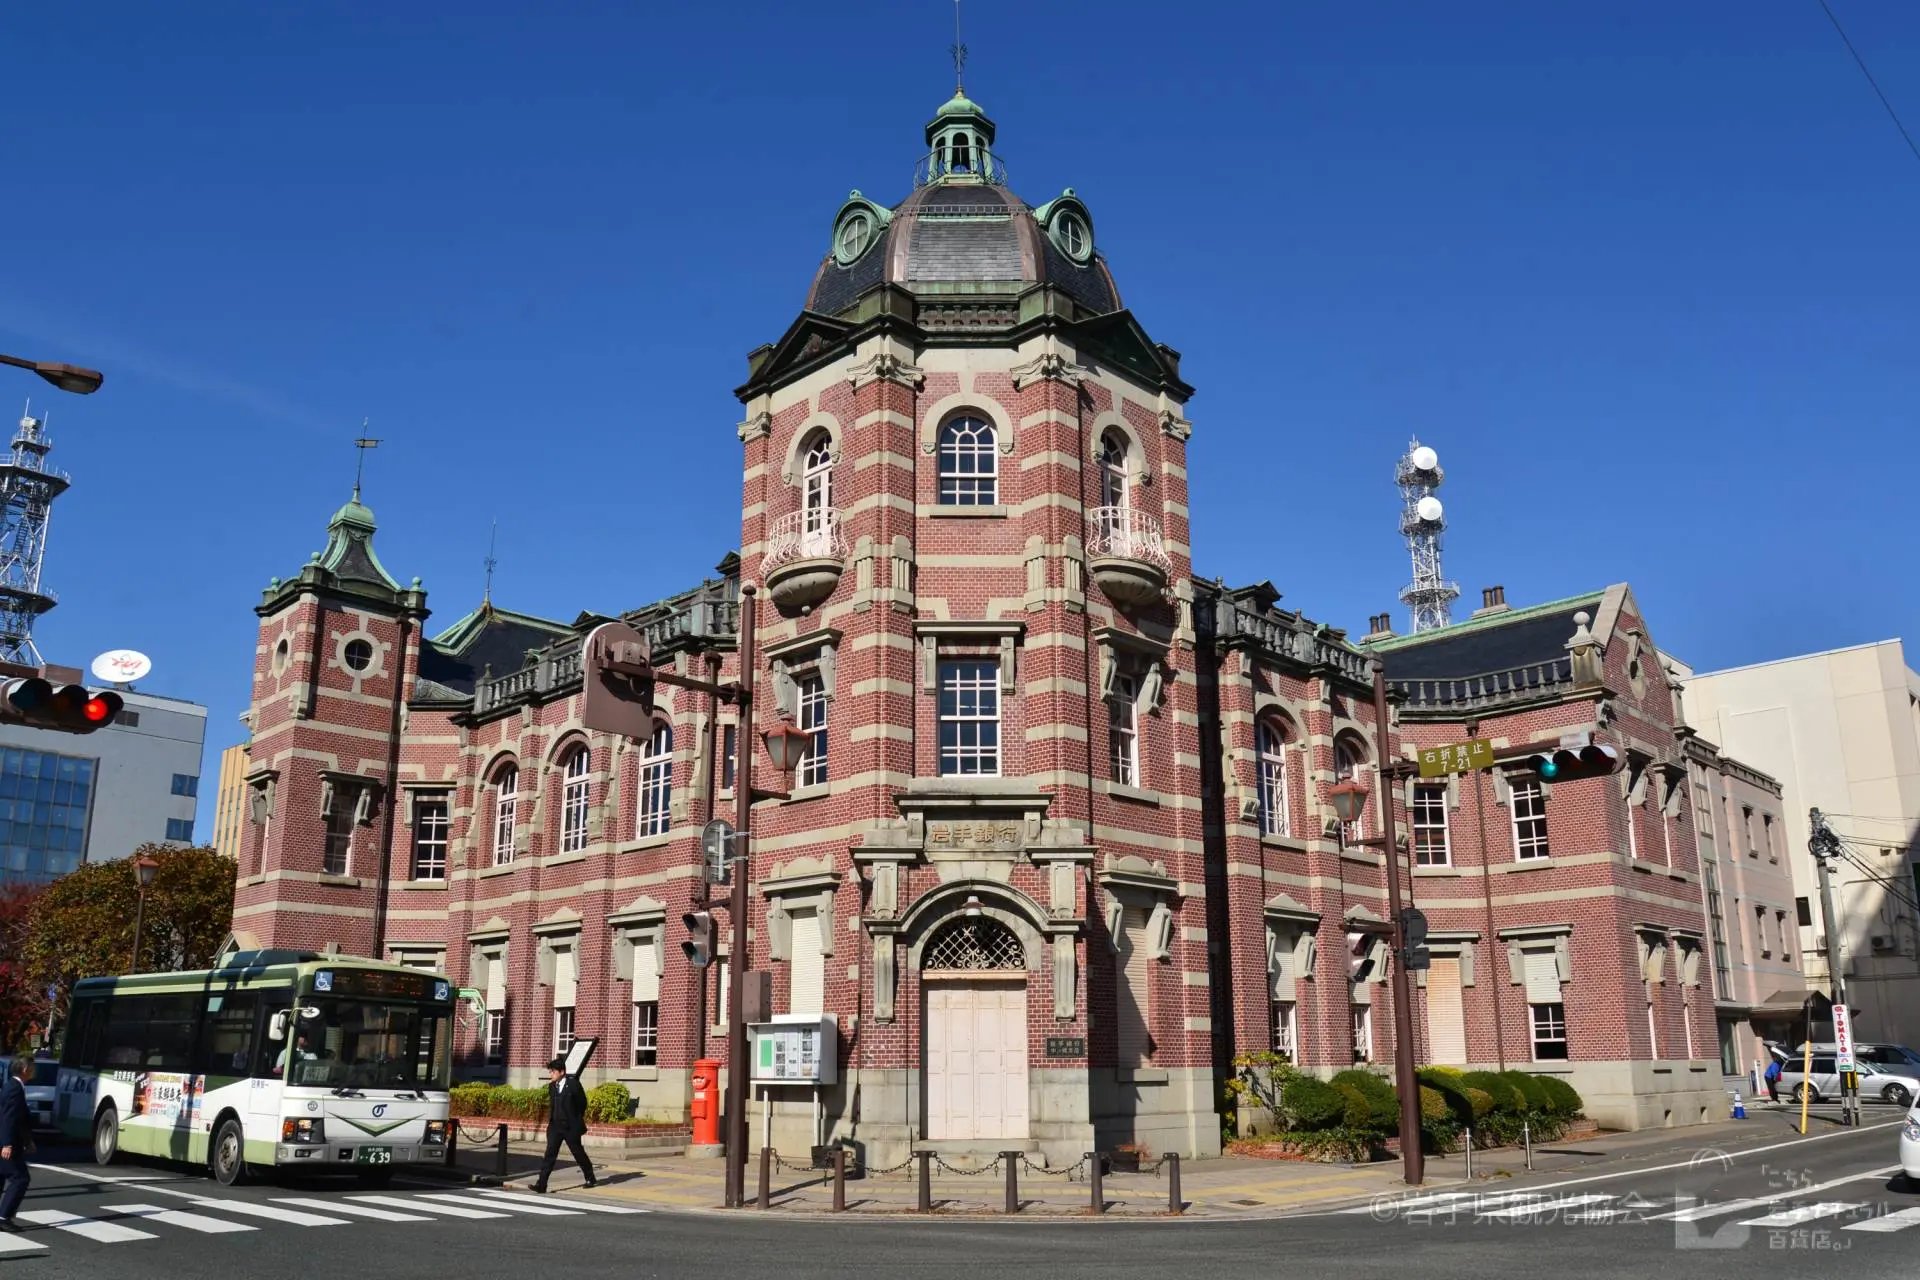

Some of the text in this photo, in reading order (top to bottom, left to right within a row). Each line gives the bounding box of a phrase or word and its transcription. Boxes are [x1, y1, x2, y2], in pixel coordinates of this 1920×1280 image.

[1425, 743, 1485, 763] 右折禁止
[1441, 757, 1472, 773] 7-21
[931, 824, 1017, 842] 岩手銀行
[1836, 1013, 1847, 1053] TOMATO
